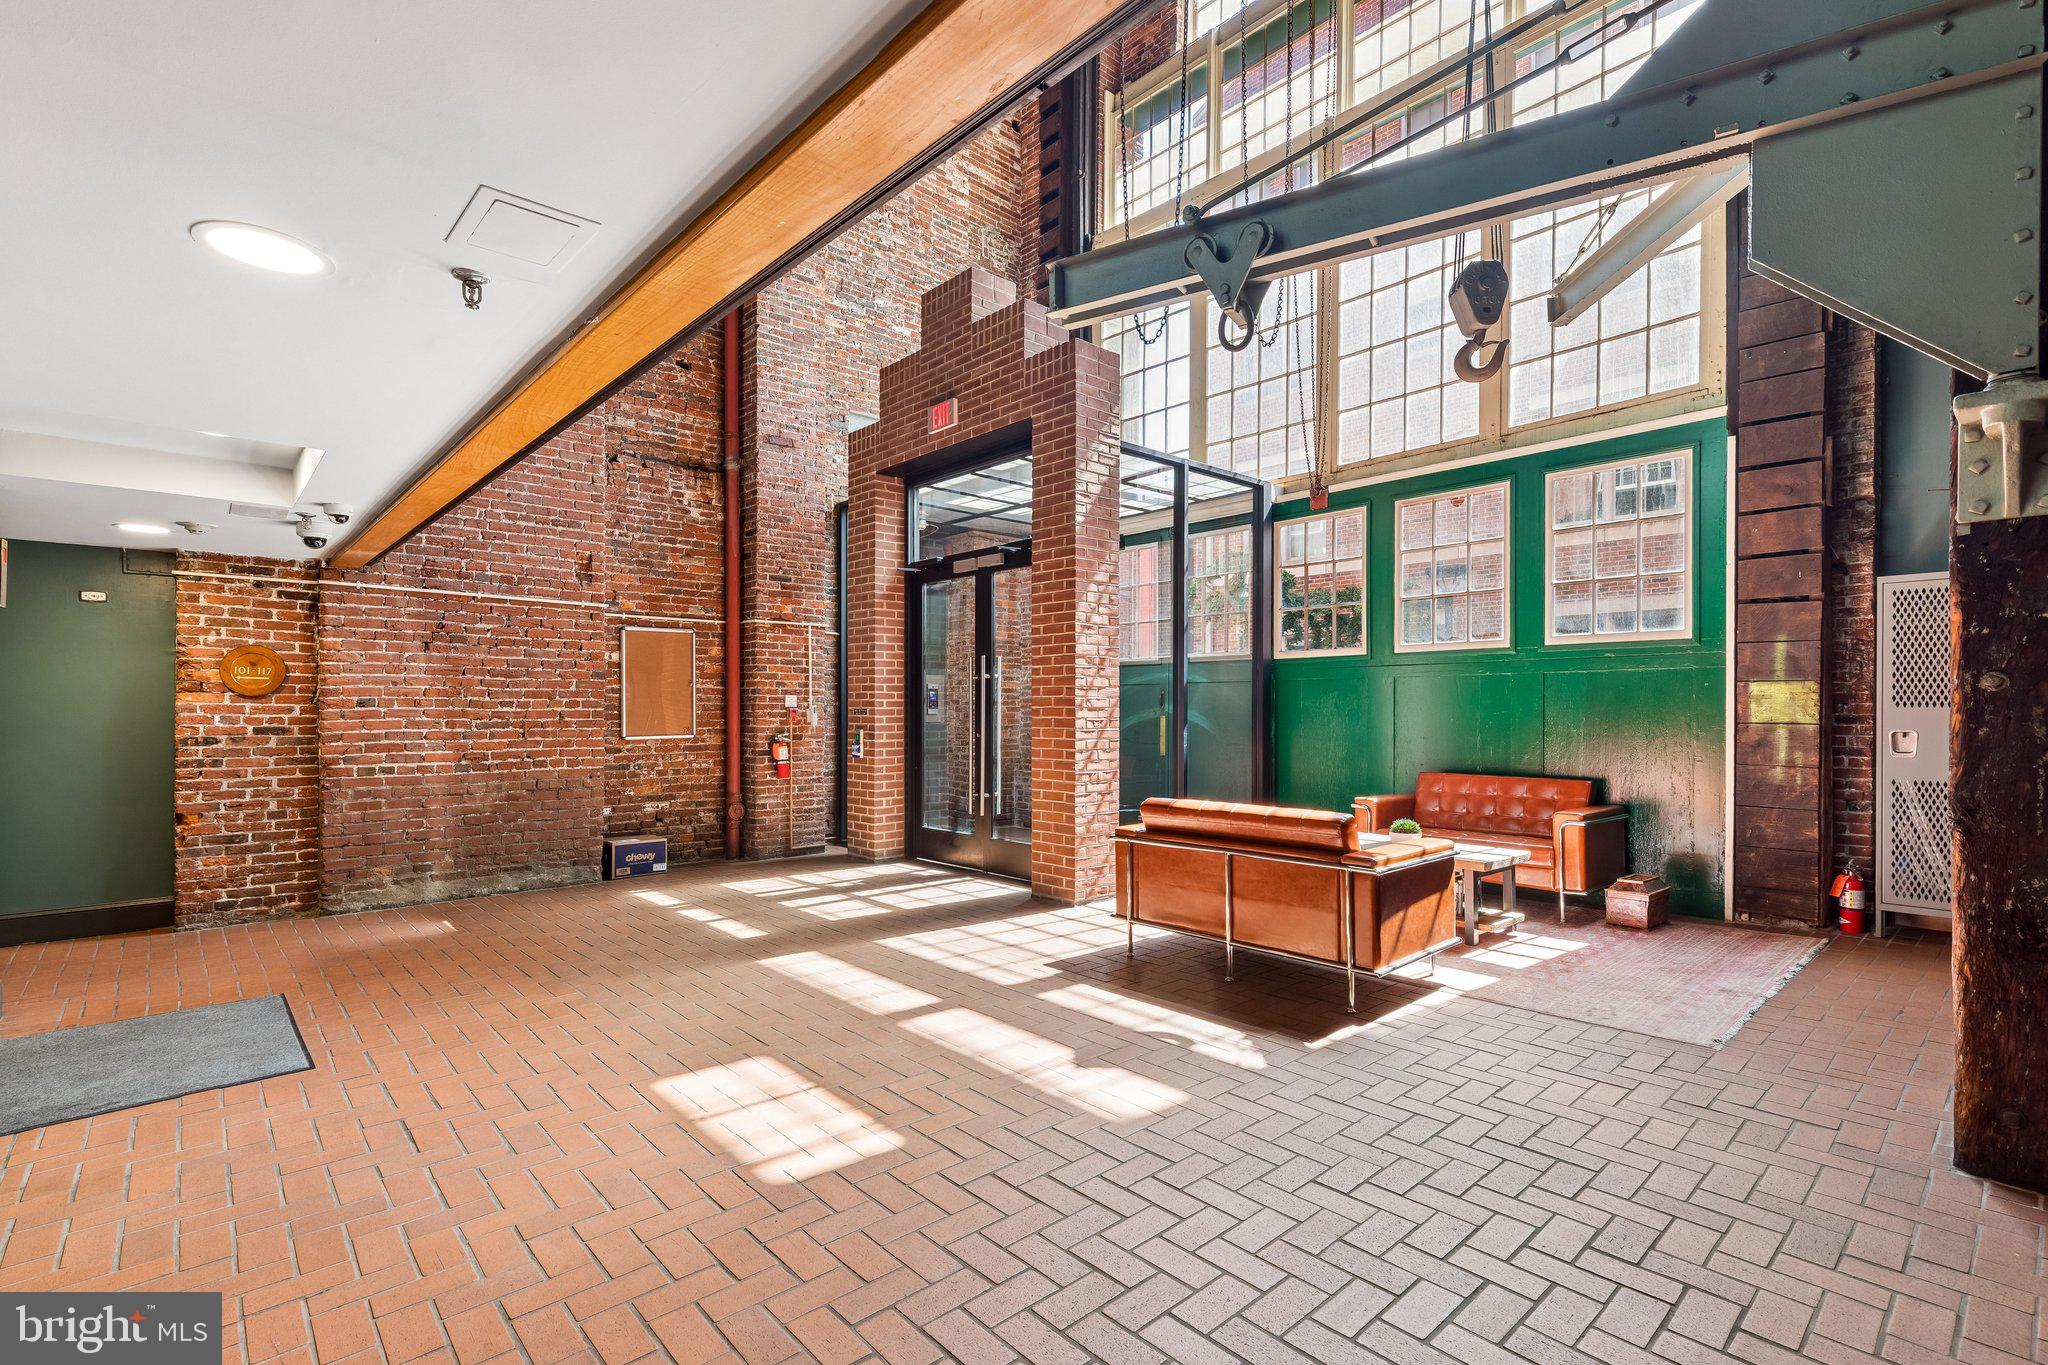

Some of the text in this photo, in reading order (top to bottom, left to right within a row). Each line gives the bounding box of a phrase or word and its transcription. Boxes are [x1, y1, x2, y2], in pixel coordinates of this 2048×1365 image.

[932, 401, 950, 430] EXIT
[234, 666, 272, 675] 101-117
[625, 852, 656, 862] chewy
